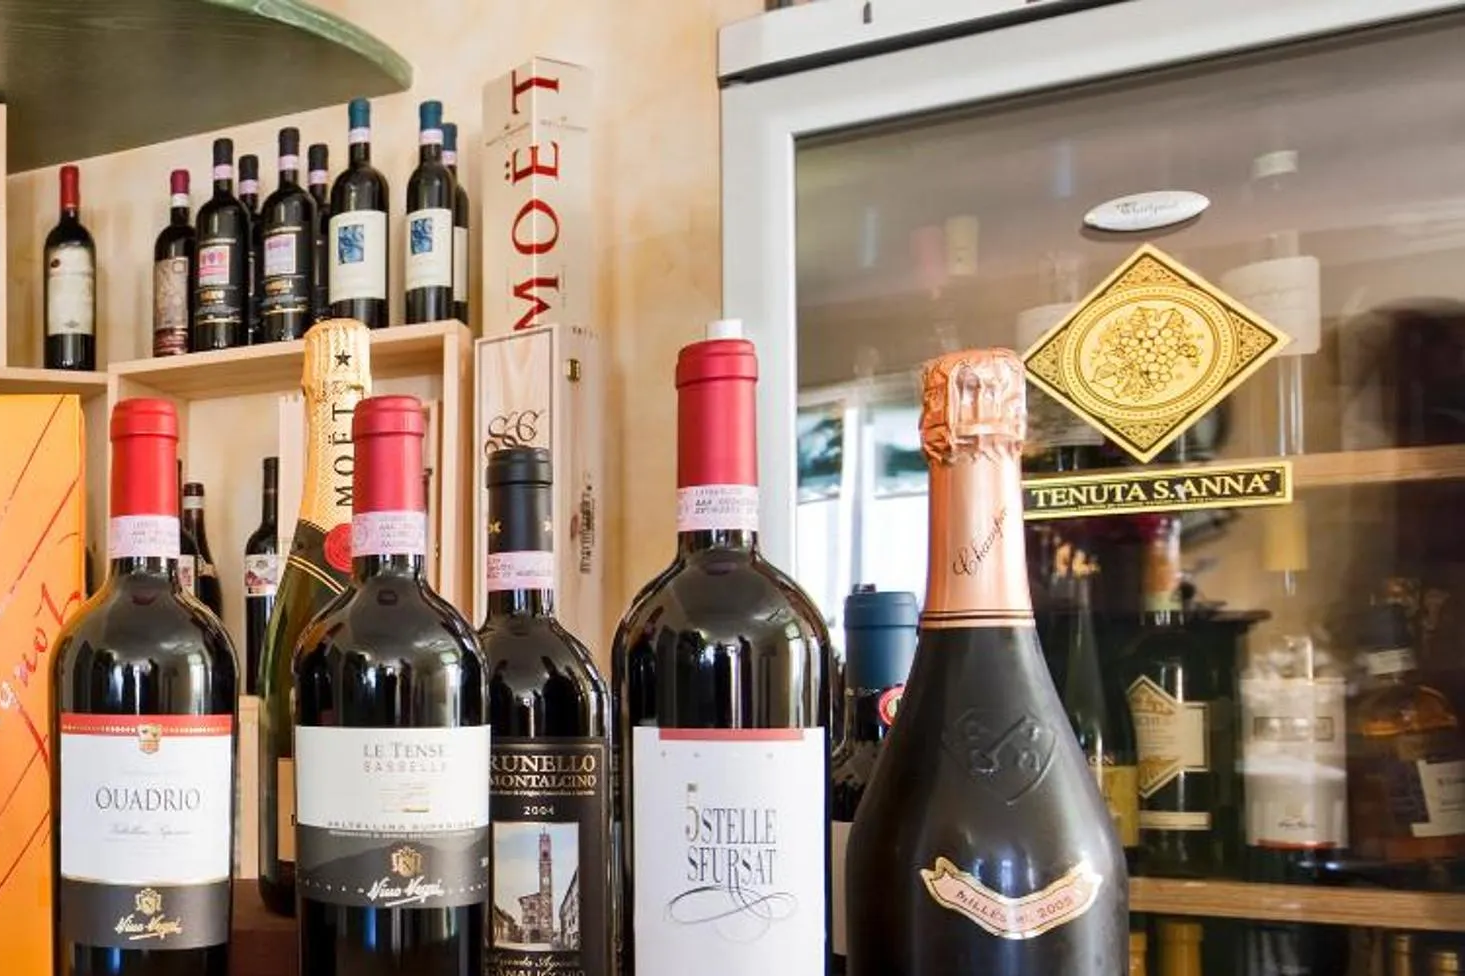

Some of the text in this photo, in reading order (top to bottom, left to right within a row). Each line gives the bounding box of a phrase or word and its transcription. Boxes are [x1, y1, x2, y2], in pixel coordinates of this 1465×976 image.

[1032, 483, 1148, 508] TENUTA
[363, 744, 385, 758] LE
[491, 754, 596, 772] RUNELLO
[701, 808, 776, 844] STELLE
[687, 847, 777, 888] SFURSAT
